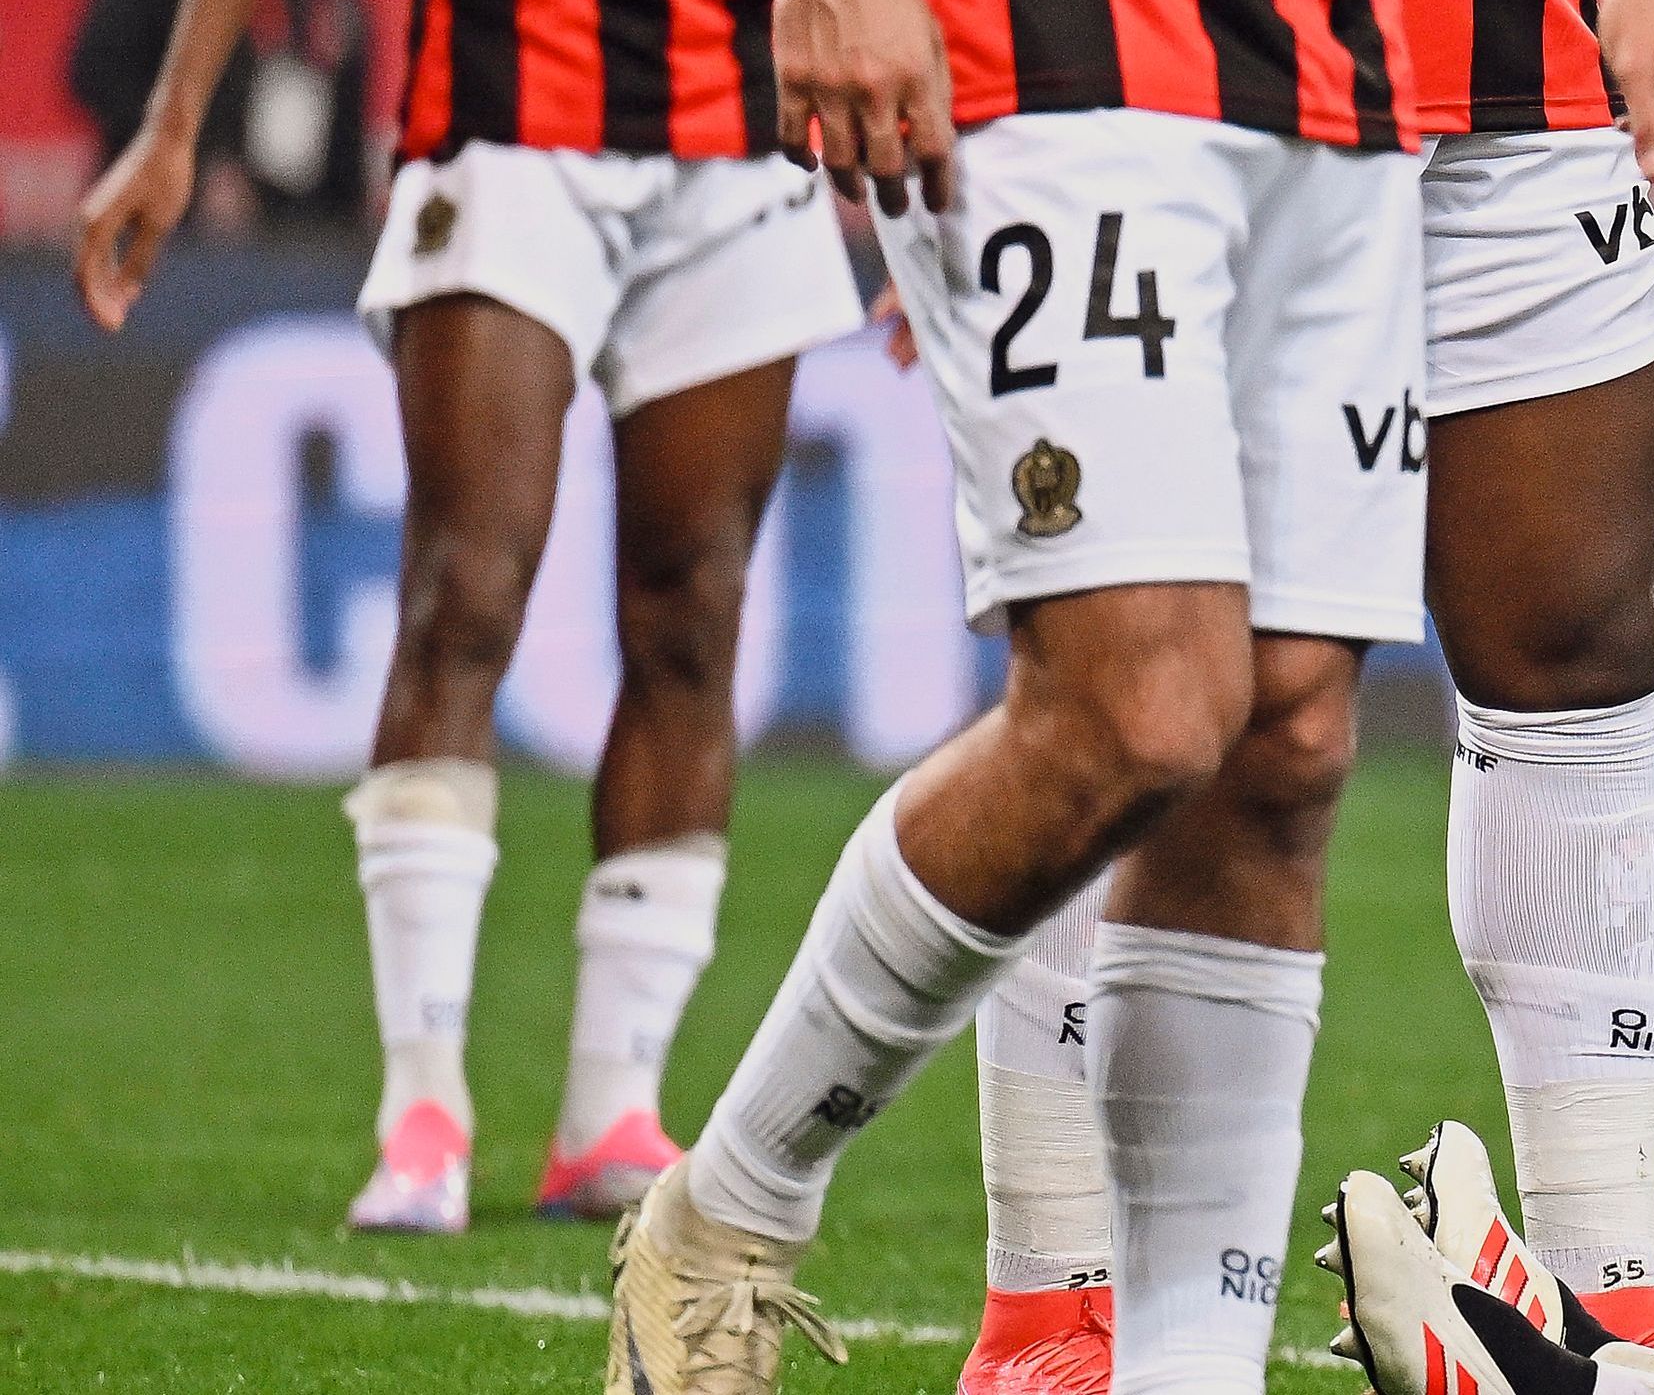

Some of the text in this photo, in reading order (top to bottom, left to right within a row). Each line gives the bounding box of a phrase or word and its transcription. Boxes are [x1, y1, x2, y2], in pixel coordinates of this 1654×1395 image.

[980, 212, 1176, 398] 24
[1221, 1247, 1281, 1280] OG
[1603, 1259, 1645, 1289] 55
[1221, 1276, 1280, 1305] NIC
